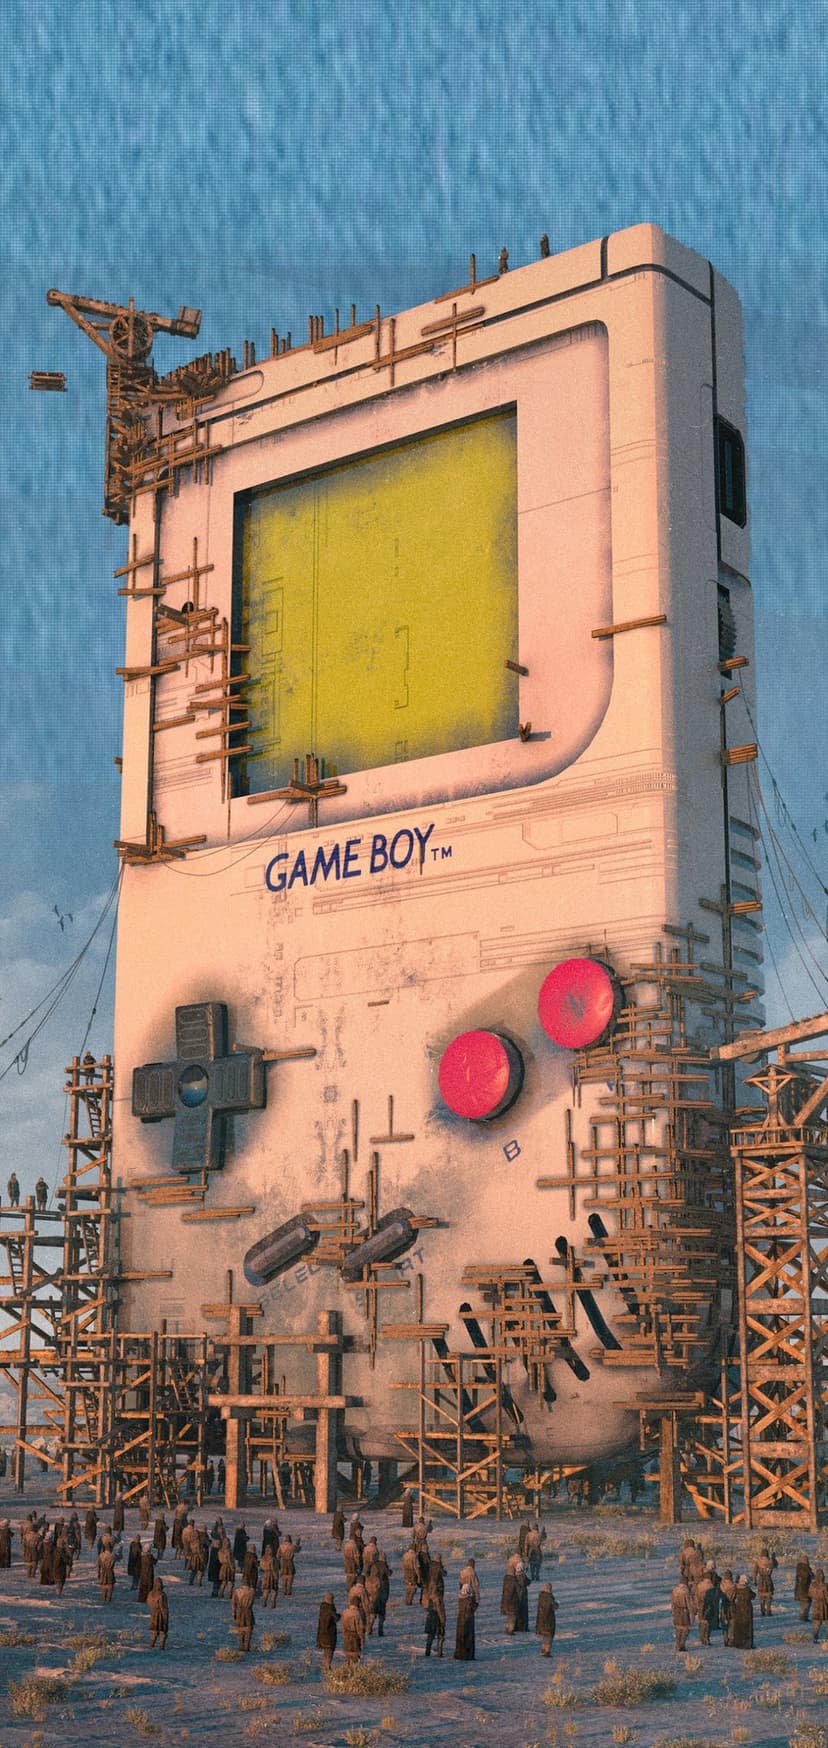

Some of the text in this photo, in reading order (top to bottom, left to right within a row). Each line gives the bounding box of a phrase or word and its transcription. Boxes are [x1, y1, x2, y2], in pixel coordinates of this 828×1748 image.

[265, 838, 362, 892] GAME
[370, 823, 436, 874] BOY
[503, 1139, 522, 1162] B
